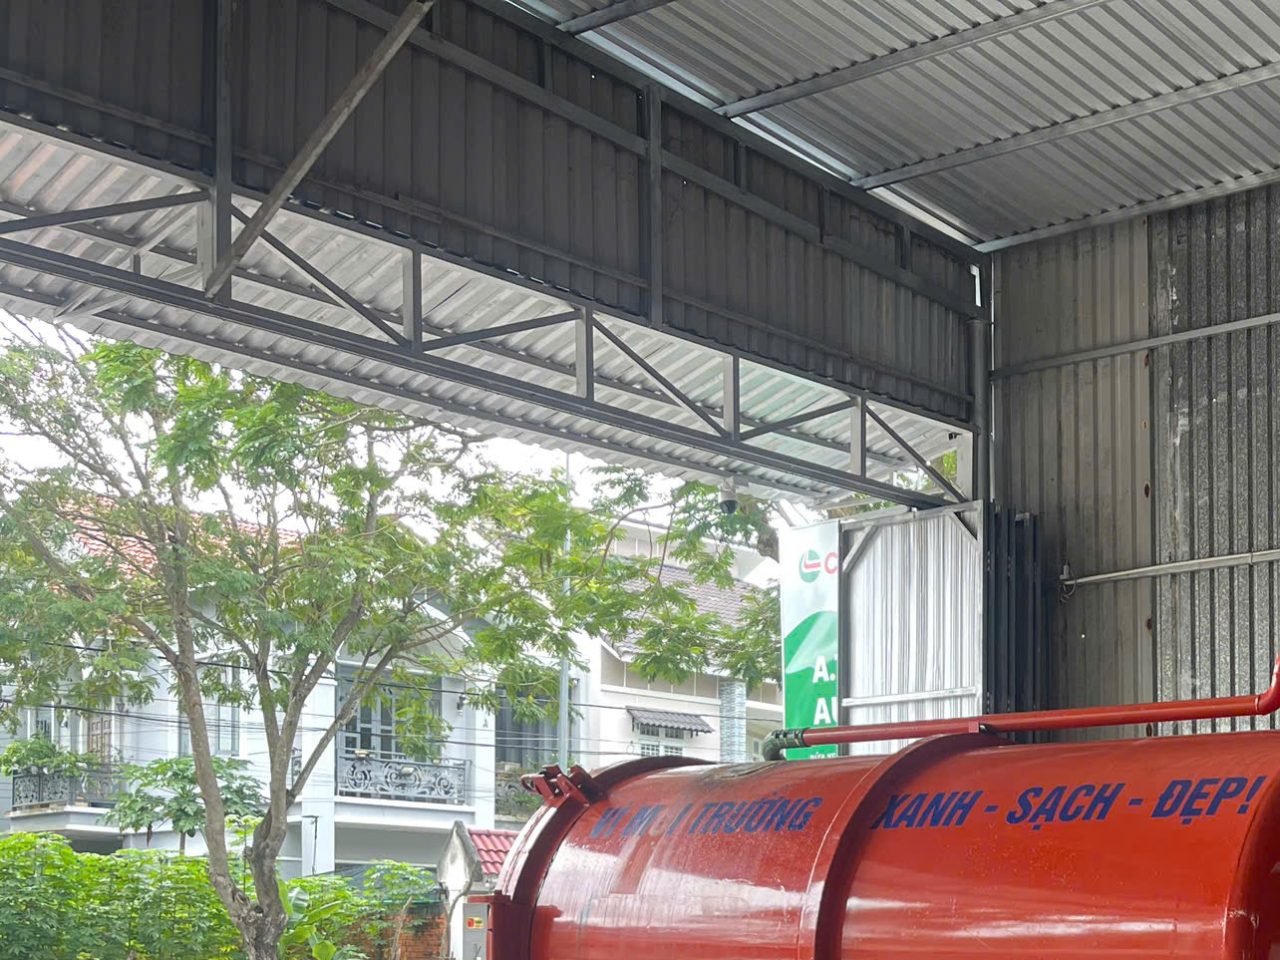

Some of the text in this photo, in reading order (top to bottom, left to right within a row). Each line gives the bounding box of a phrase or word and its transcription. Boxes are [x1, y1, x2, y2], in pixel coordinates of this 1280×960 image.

[870, 789, 984, 831] XANH
[1006, 782, 1126, 831] SẠCH
[1151, 775, 1268, 825] ĐẸP!
